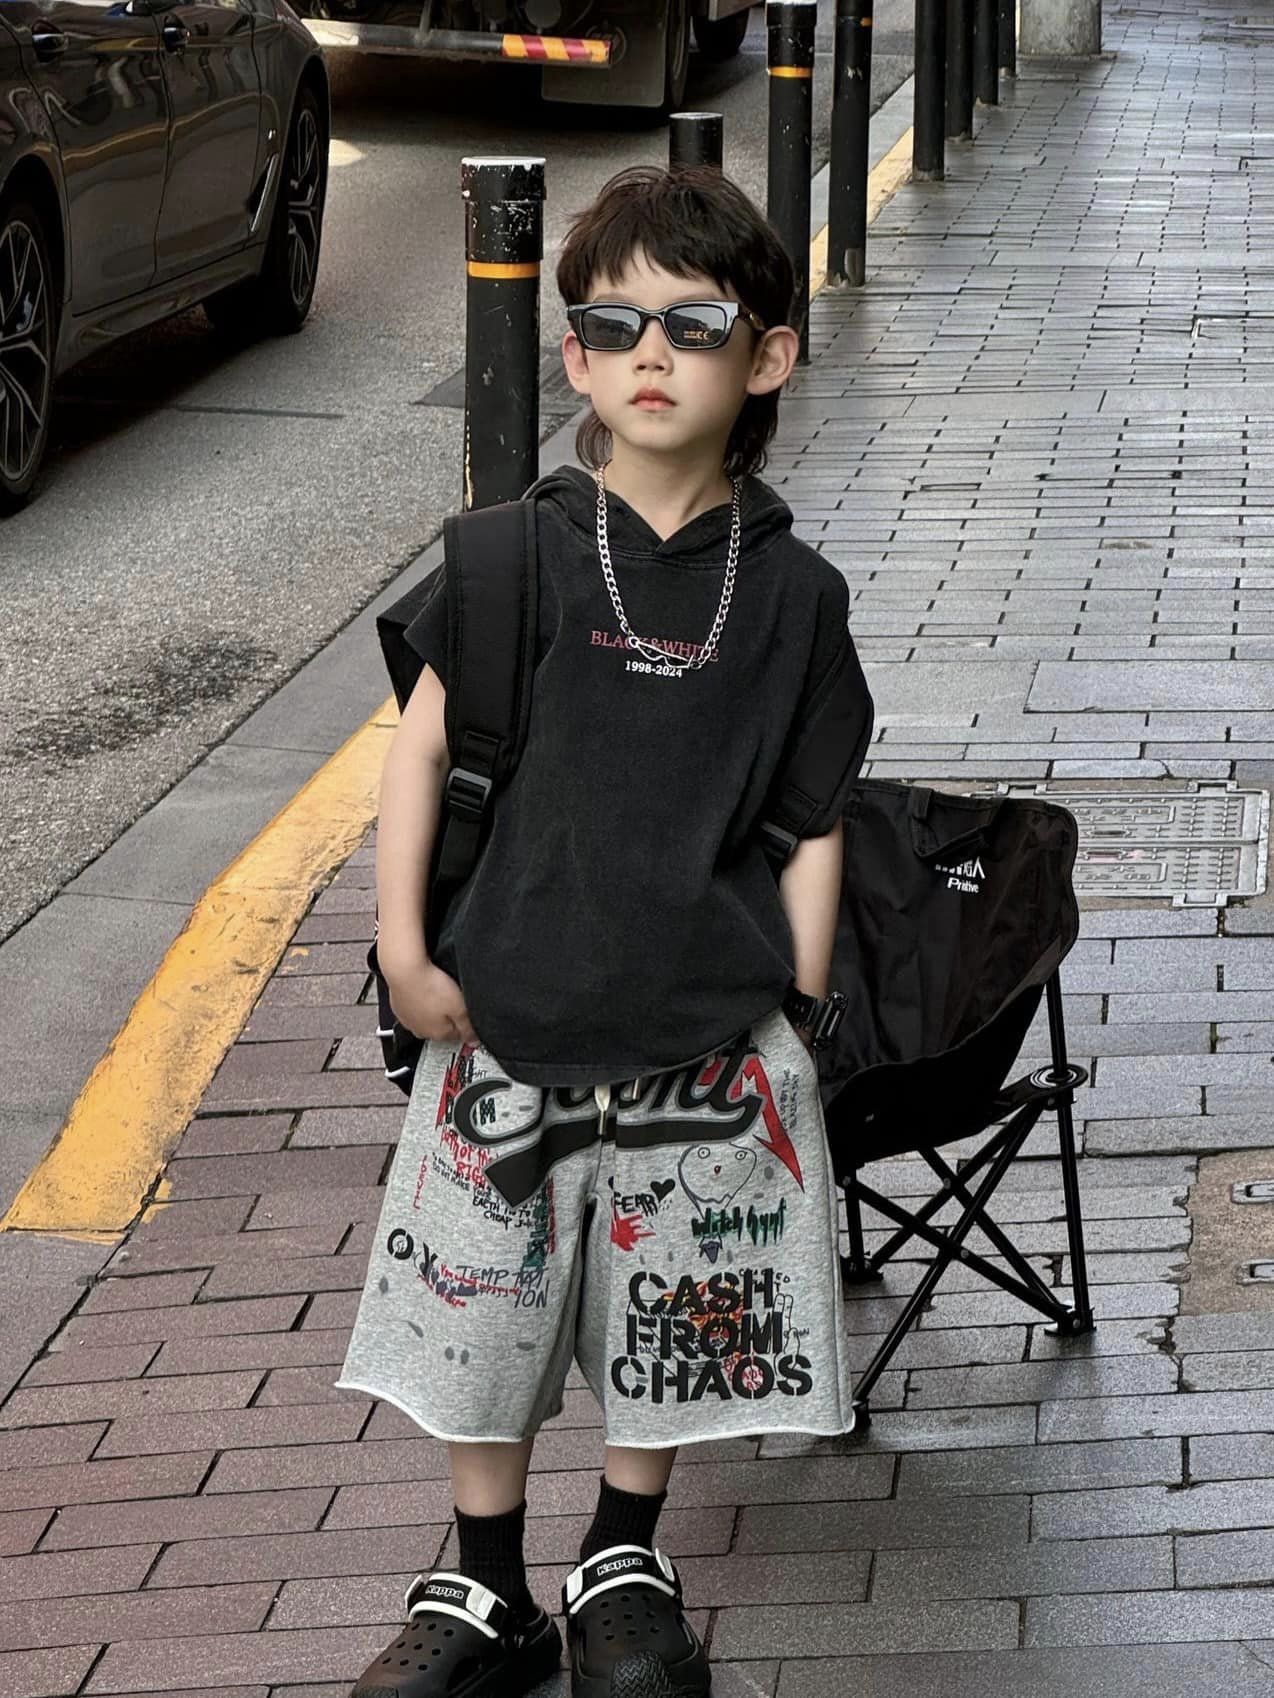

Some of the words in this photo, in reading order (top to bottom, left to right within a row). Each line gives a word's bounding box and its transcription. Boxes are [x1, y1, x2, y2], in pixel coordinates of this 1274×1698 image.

[625, 661, 683, 678] 1998-2024
[456, 1265, 509, 1287] TEMP
[628, 1267, 774, 1316] CASH
[626, 1311, 784, 1360] FROM
[611, 1354, 814, 1404] CHAOS
[597, 1556, 643, 1576] Kappa
[425, 1584, 465, 1599] Kappa
